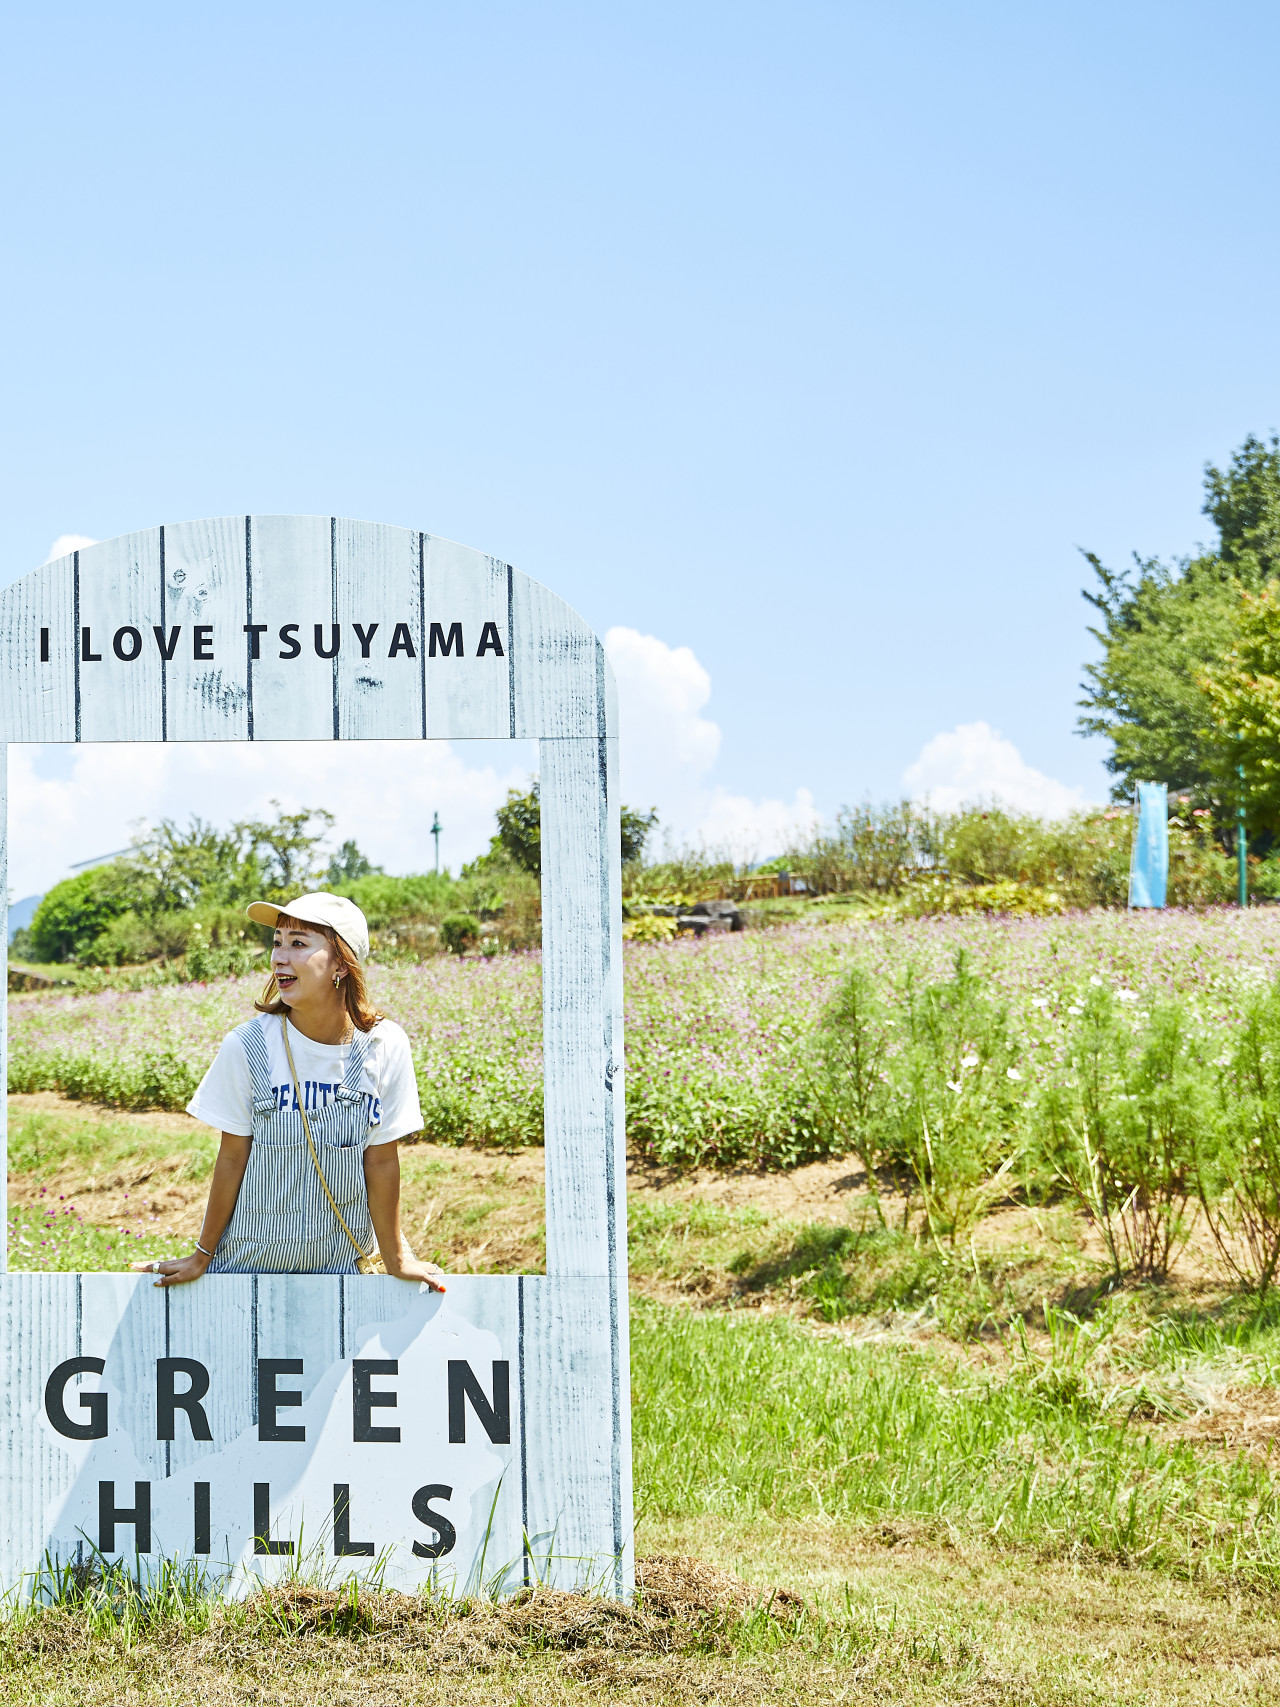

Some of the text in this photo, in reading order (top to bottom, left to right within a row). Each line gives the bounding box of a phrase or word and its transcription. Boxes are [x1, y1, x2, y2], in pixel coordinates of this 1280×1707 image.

[40, 621, 506, 662] I LOVE TSUYAMA
[44, 1356, 512, 1445] GREEN
[98, 1480, 457, 1559] HILLS
